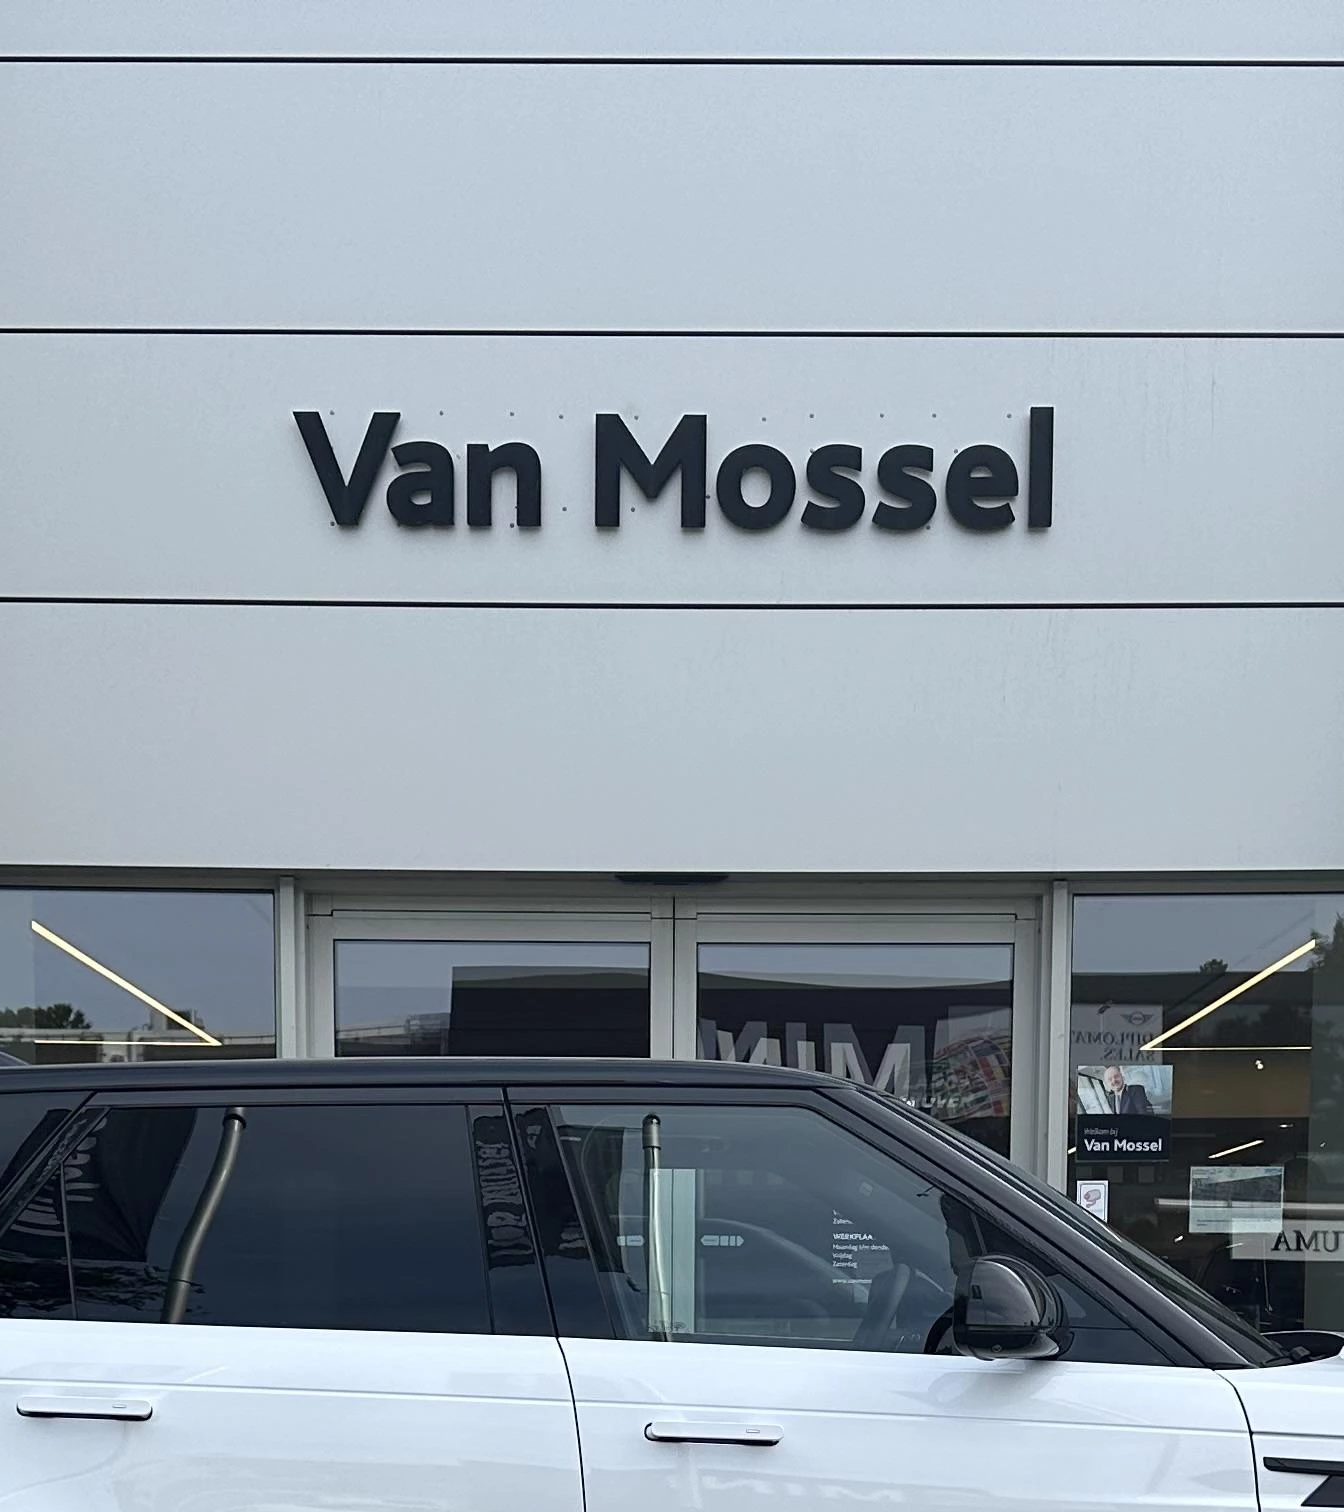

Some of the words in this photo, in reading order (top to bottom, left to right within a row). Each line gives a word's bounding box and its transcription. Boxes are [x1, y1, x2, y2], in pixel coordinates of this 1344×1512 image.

[292, 410, 542, 528] Van
[594, 405, 1055, 531] Mossel
[1084, 1138, 1110, 1152] Van
[1114, 1138, 1163, 1152] Mossel
